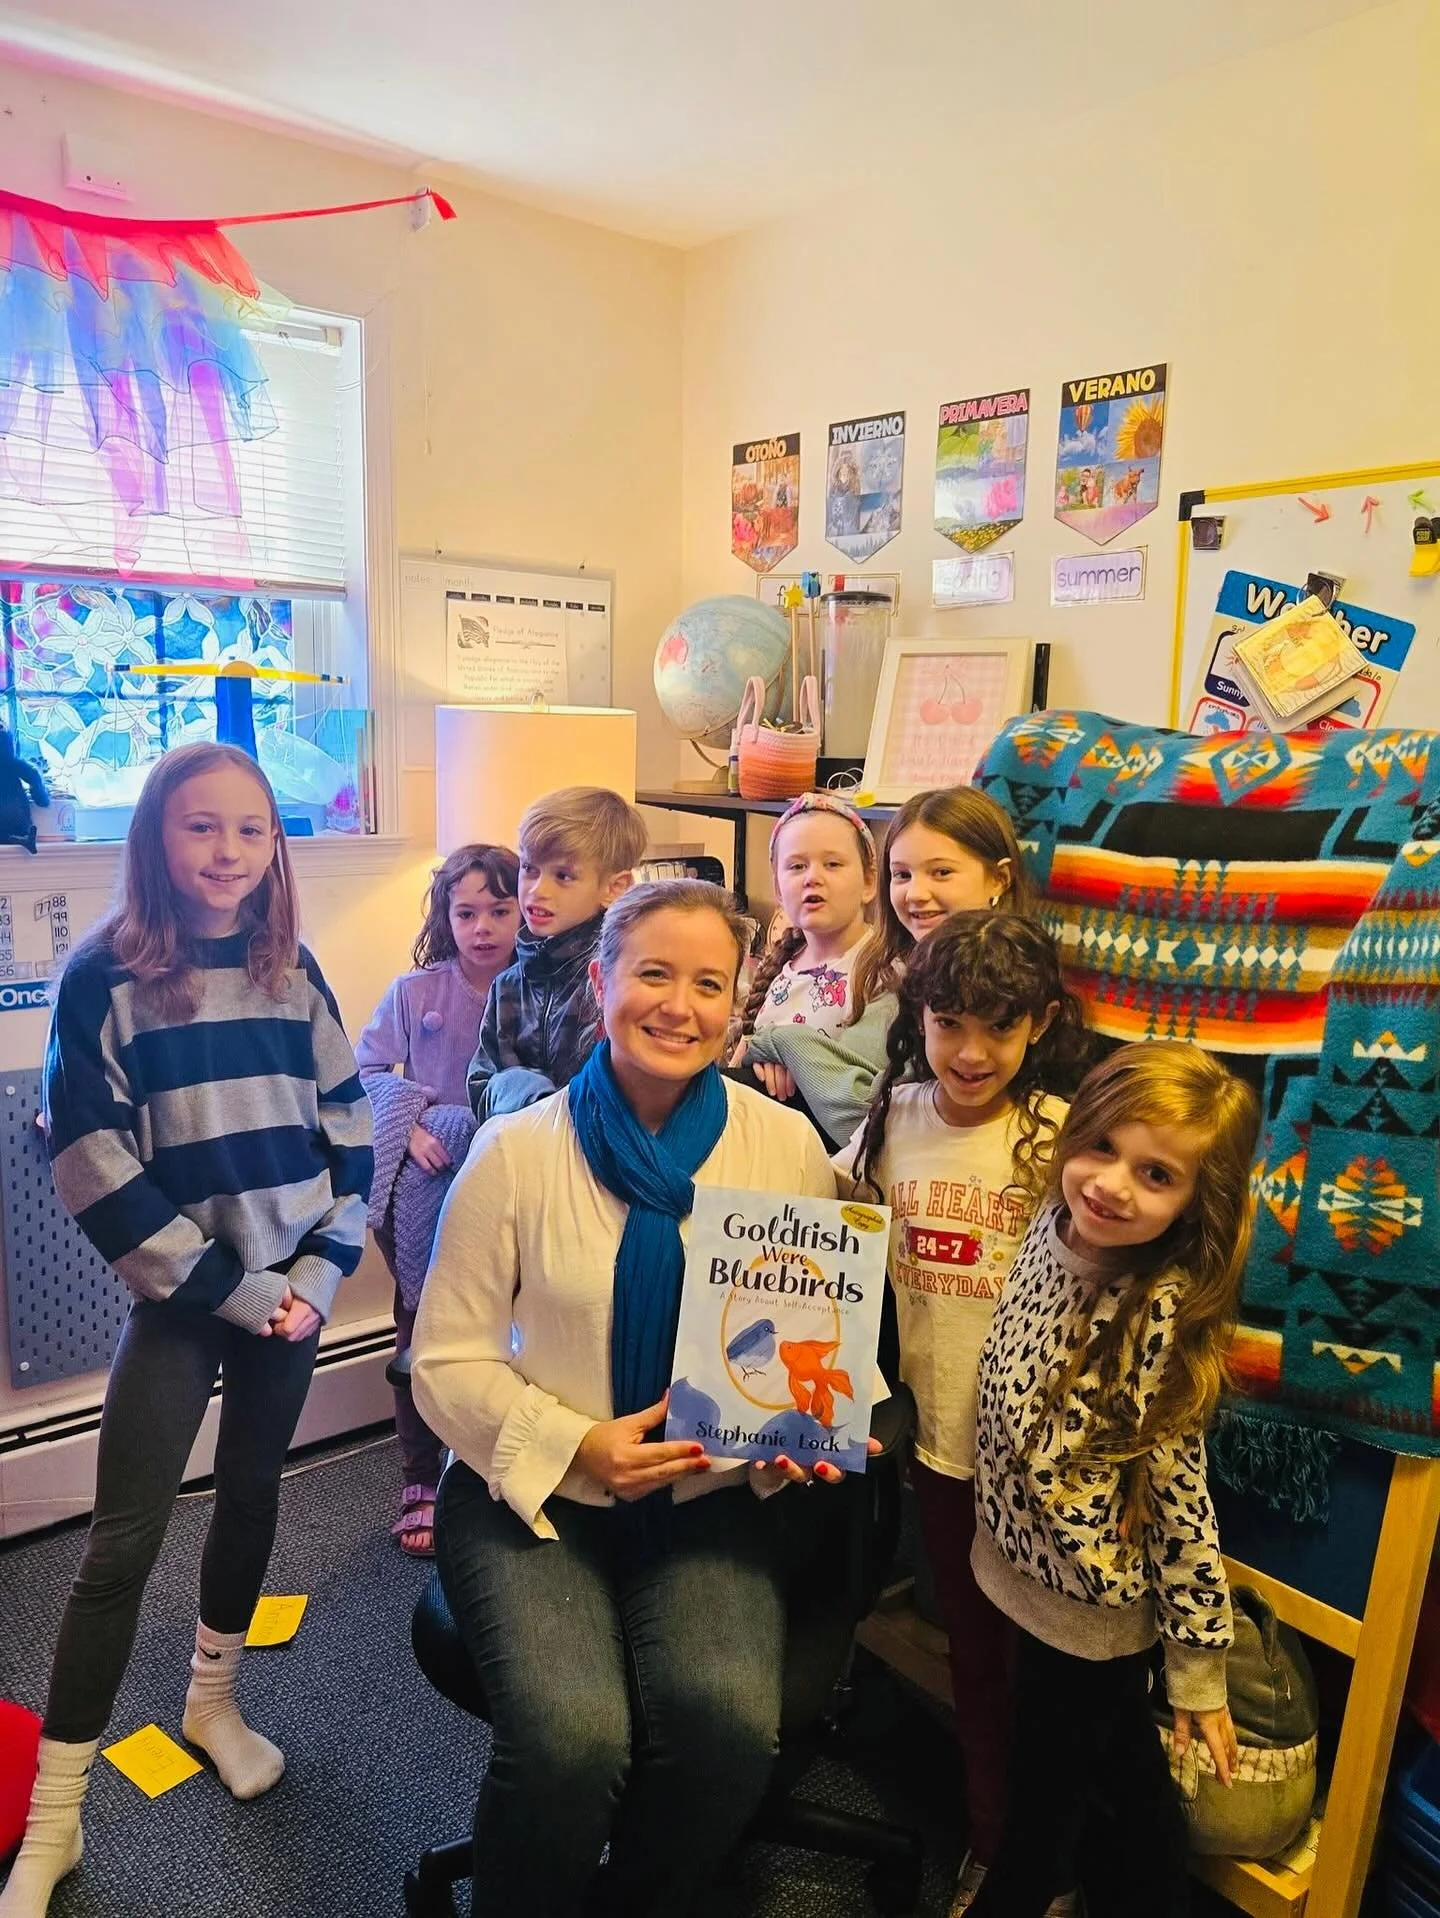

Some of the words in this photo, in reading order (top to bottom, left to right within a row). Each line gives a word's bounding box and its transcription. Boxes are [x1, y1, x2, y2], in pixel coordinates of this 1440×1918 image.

[1069, 369, 1156, 403] VERANO
[939, 393, 1028, 425] PRIMAVERA
[831, 415, 904, 446] INVIERNO
[745, 437, 786, 463] OTOÑO
[1057, 566, 1140, 588] summer
[0, 898, 7, 909] 2
[37, 901, 50, 914] 77
[52, 896, 66, 908] 88
[0, 914, 10, 926] 3
[53, 912, 67, 922] 99
[55, 927, 68, 937] 110
[56, 944, 68, 954] 121
[783, 1203, 797, 1222] If
[926, 1181, 1024, 1237] HEART
[723, 1213, 860, 1254] Goldfish
[762, 1245, 809, 1266] Were
[917, 1235, 963, 1259] 24-7
[709, 1257, 864, 1303] Bluebirds
[755, 1296, 778, 1307] About
[695, 1421, 788, 1448] Stephanie
[799, 1428, 840, 1453] Lock
